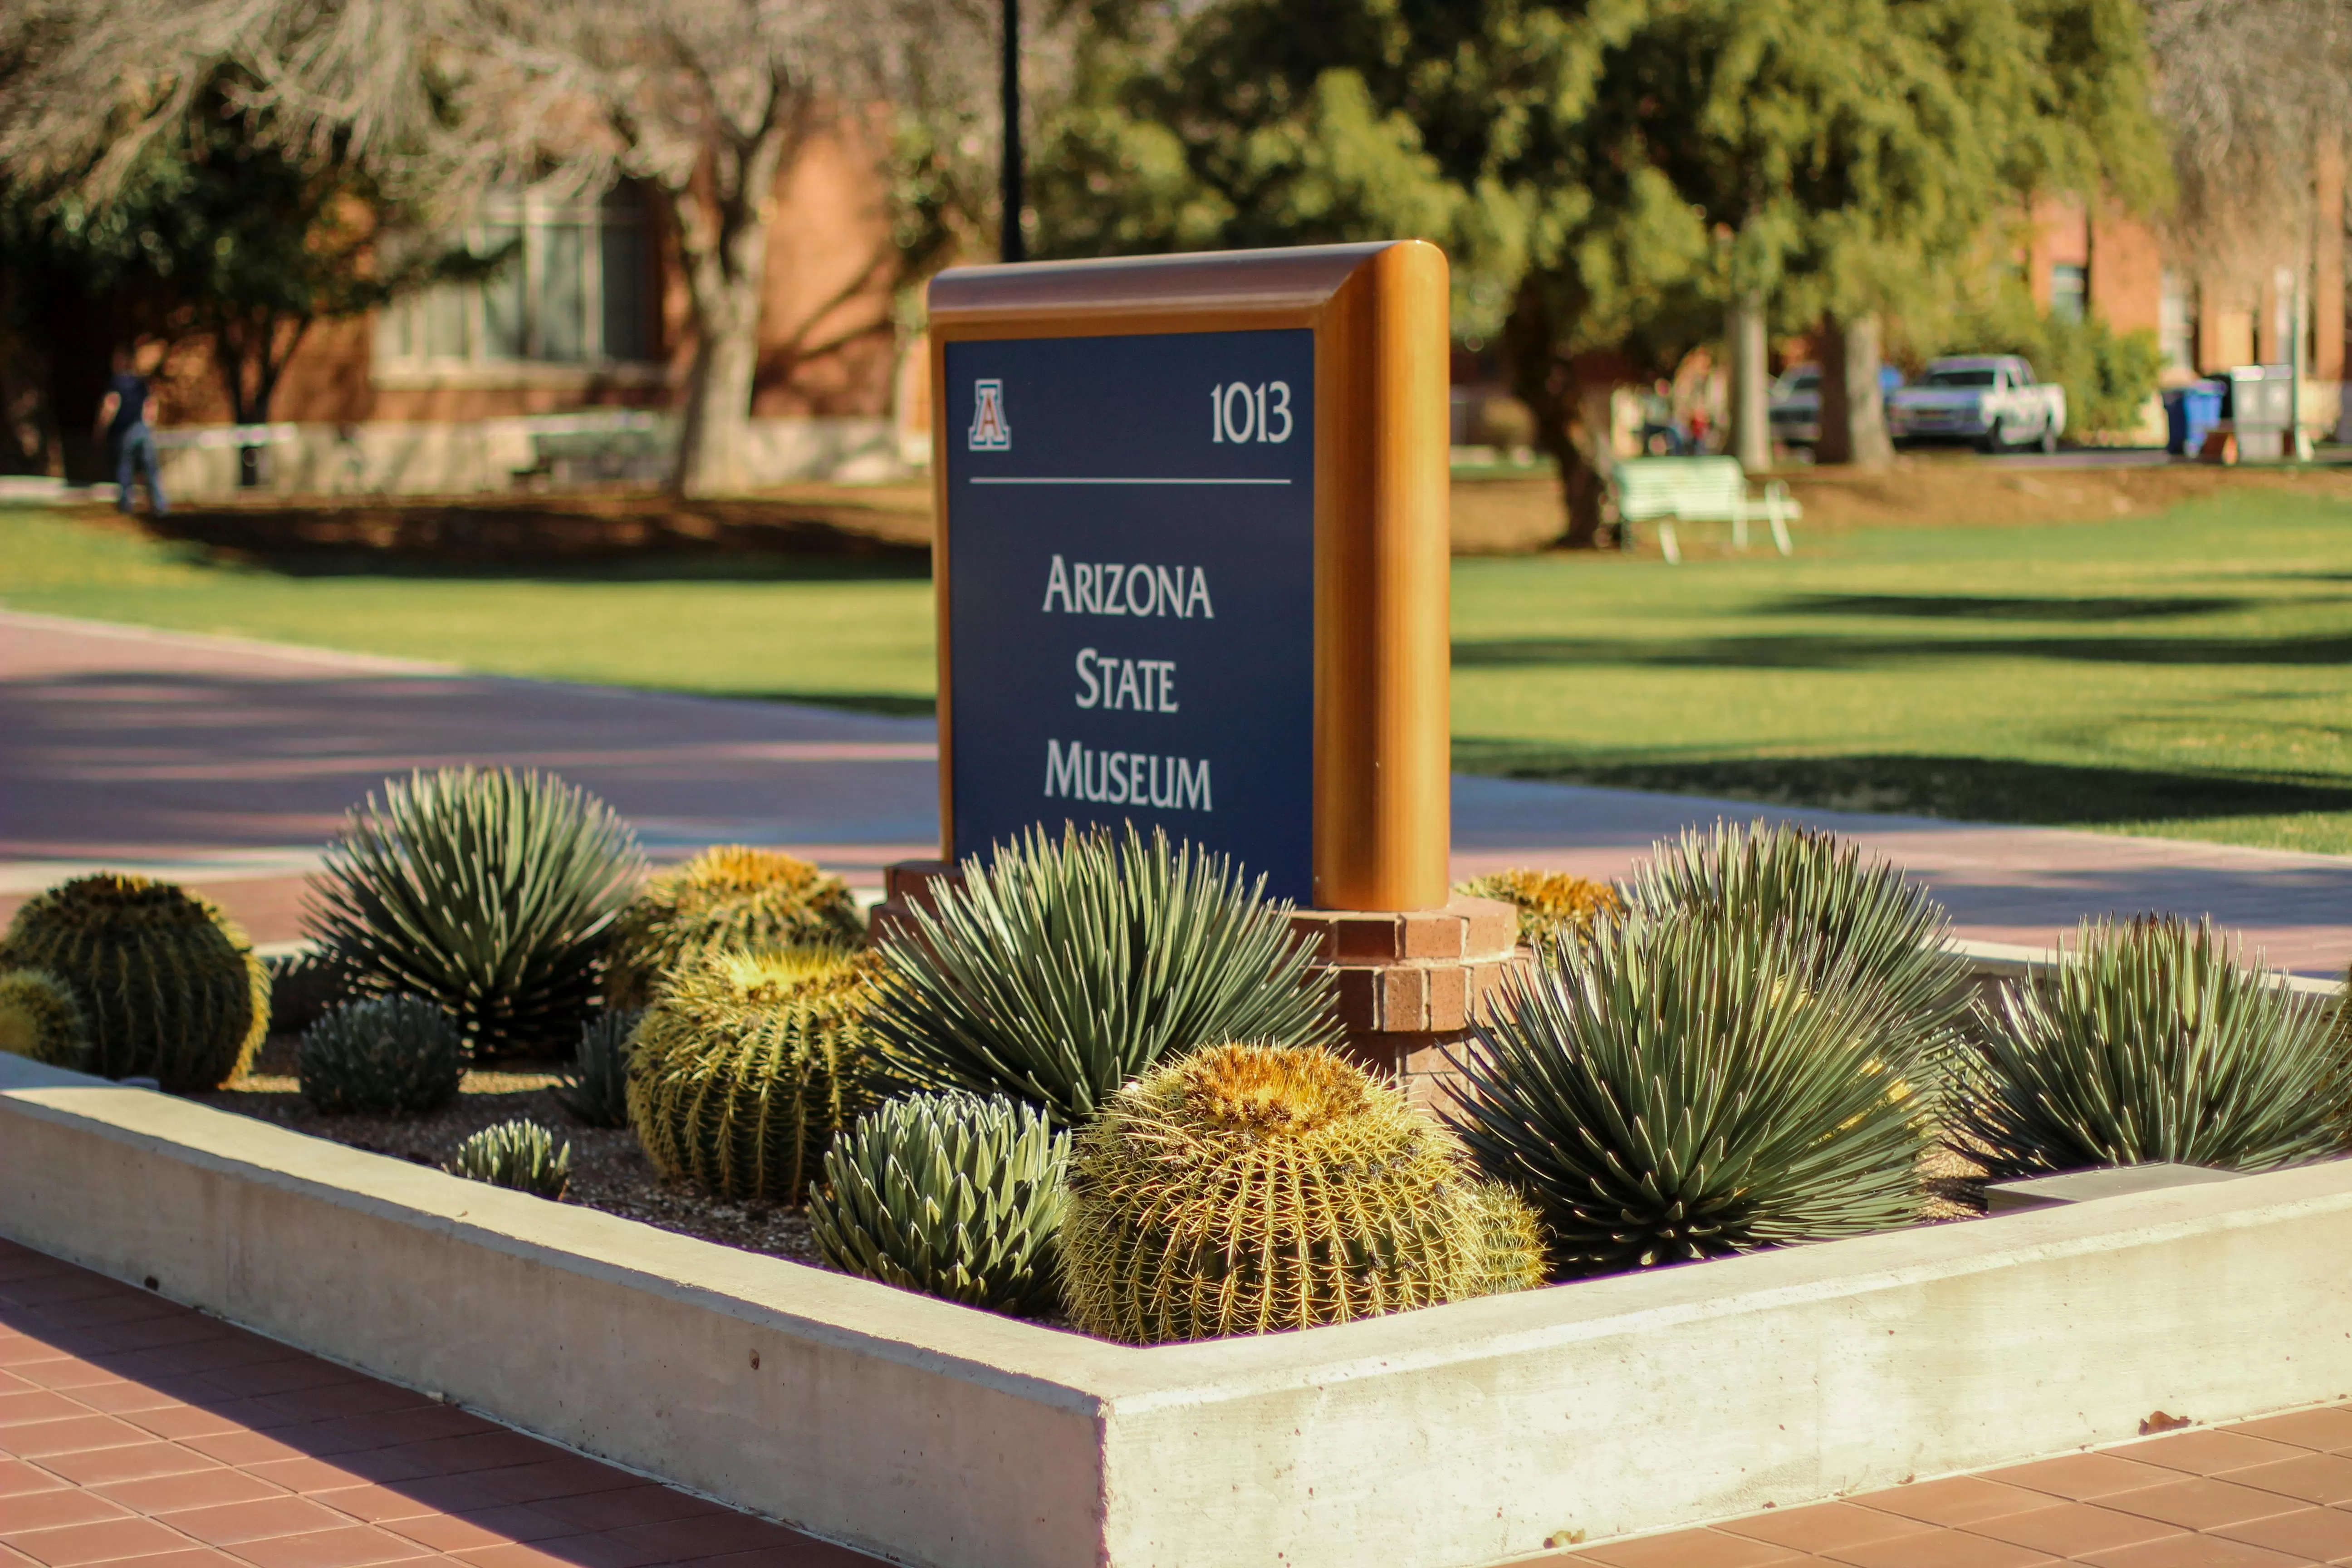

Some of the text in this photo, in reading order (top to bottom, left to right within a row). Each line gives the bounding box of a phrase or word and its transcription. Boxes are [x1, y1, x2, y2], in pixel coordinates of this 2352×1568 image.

[969, 379, 1010, 451] A
[1210, 381, 1293, 443] 1013
[1043, 554, 1214, 619] ARIZONA
[1075, 648, 1178, 713] STATE
[1044, 739, 1212, 813] MUSEUM
